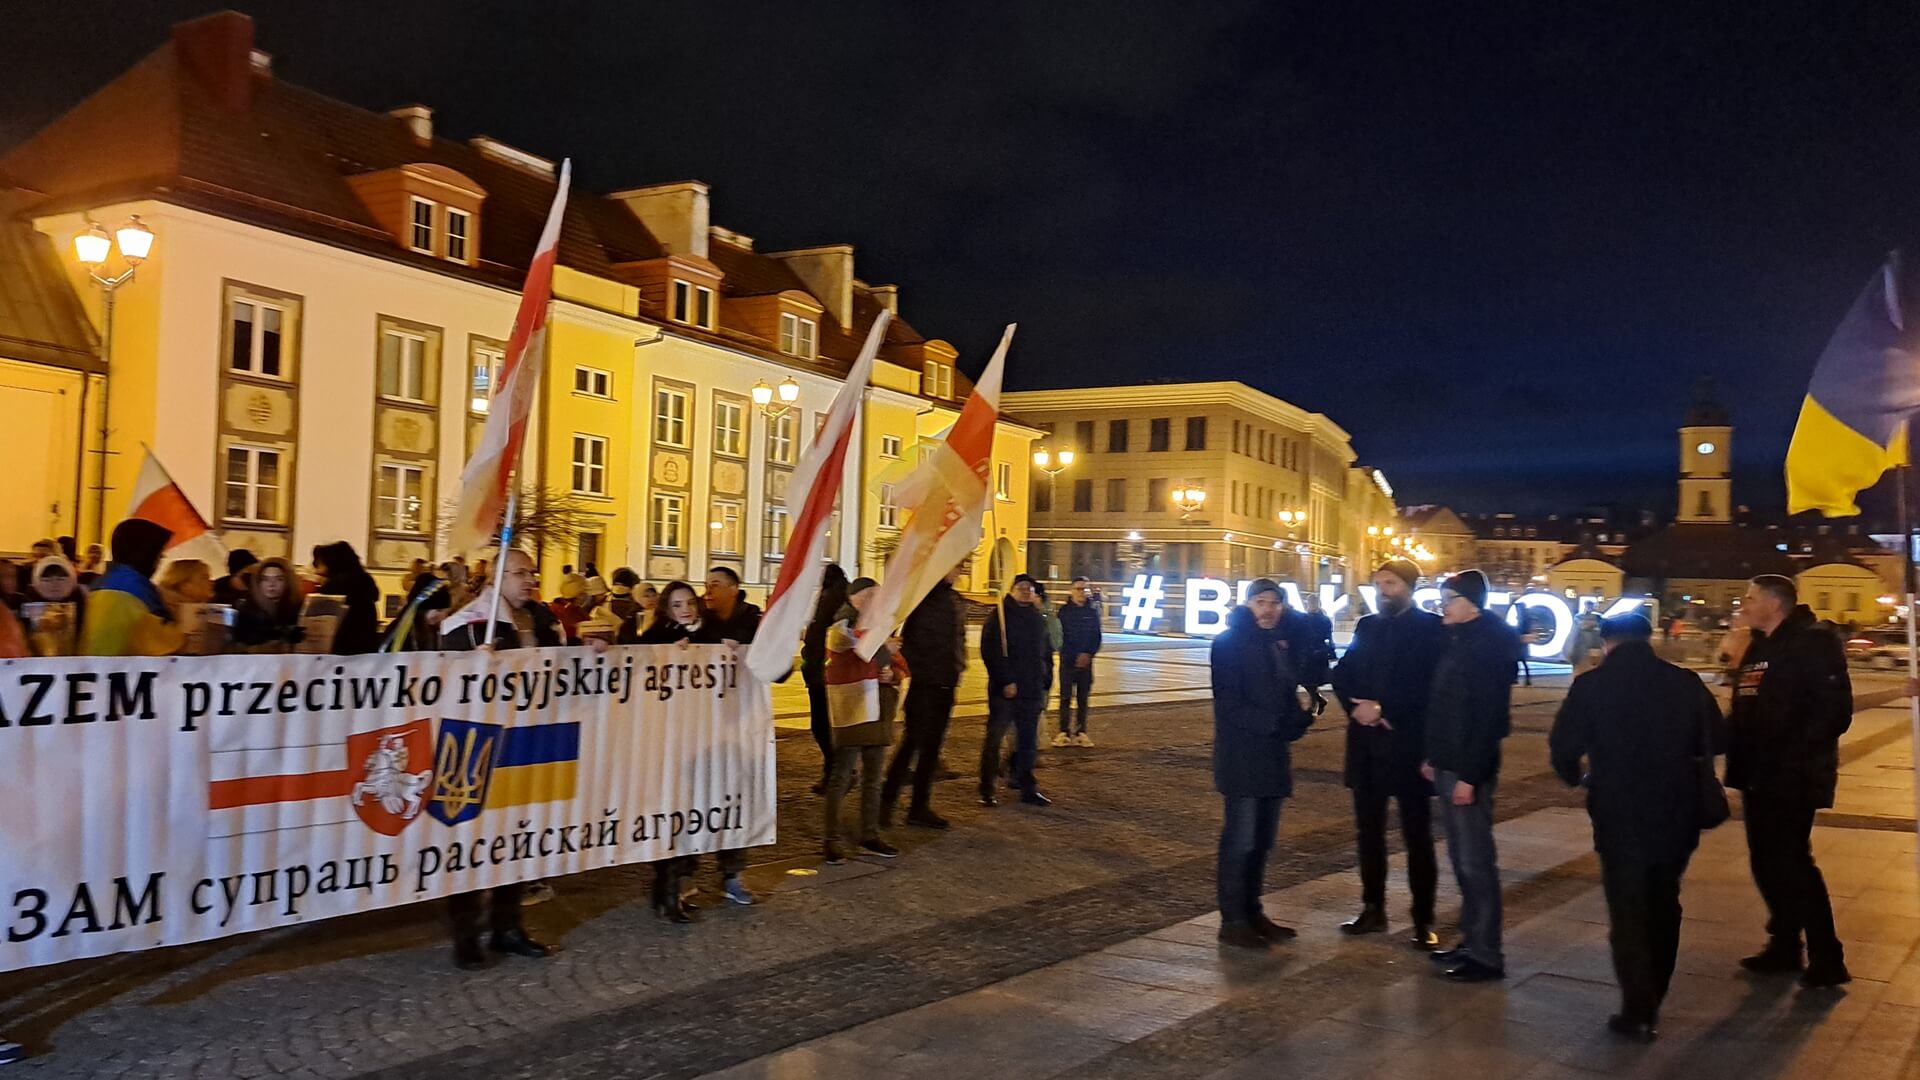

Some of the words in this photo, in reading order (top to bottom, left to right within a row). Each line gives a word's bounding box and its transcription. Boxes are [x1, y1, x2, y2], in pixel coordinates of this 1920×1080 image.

[180, 664, 443, 732] przeciwko
[458, 657, 634, 711] rosyjskiej
[645, 655, 738, 701] agresji
[0, 873, 166, 942] ЗАМ
[190, 853, 399, 927] супраць
[415, 809, 620, 891] расейскай
[633, 794, 743, 850] агрэсіі
